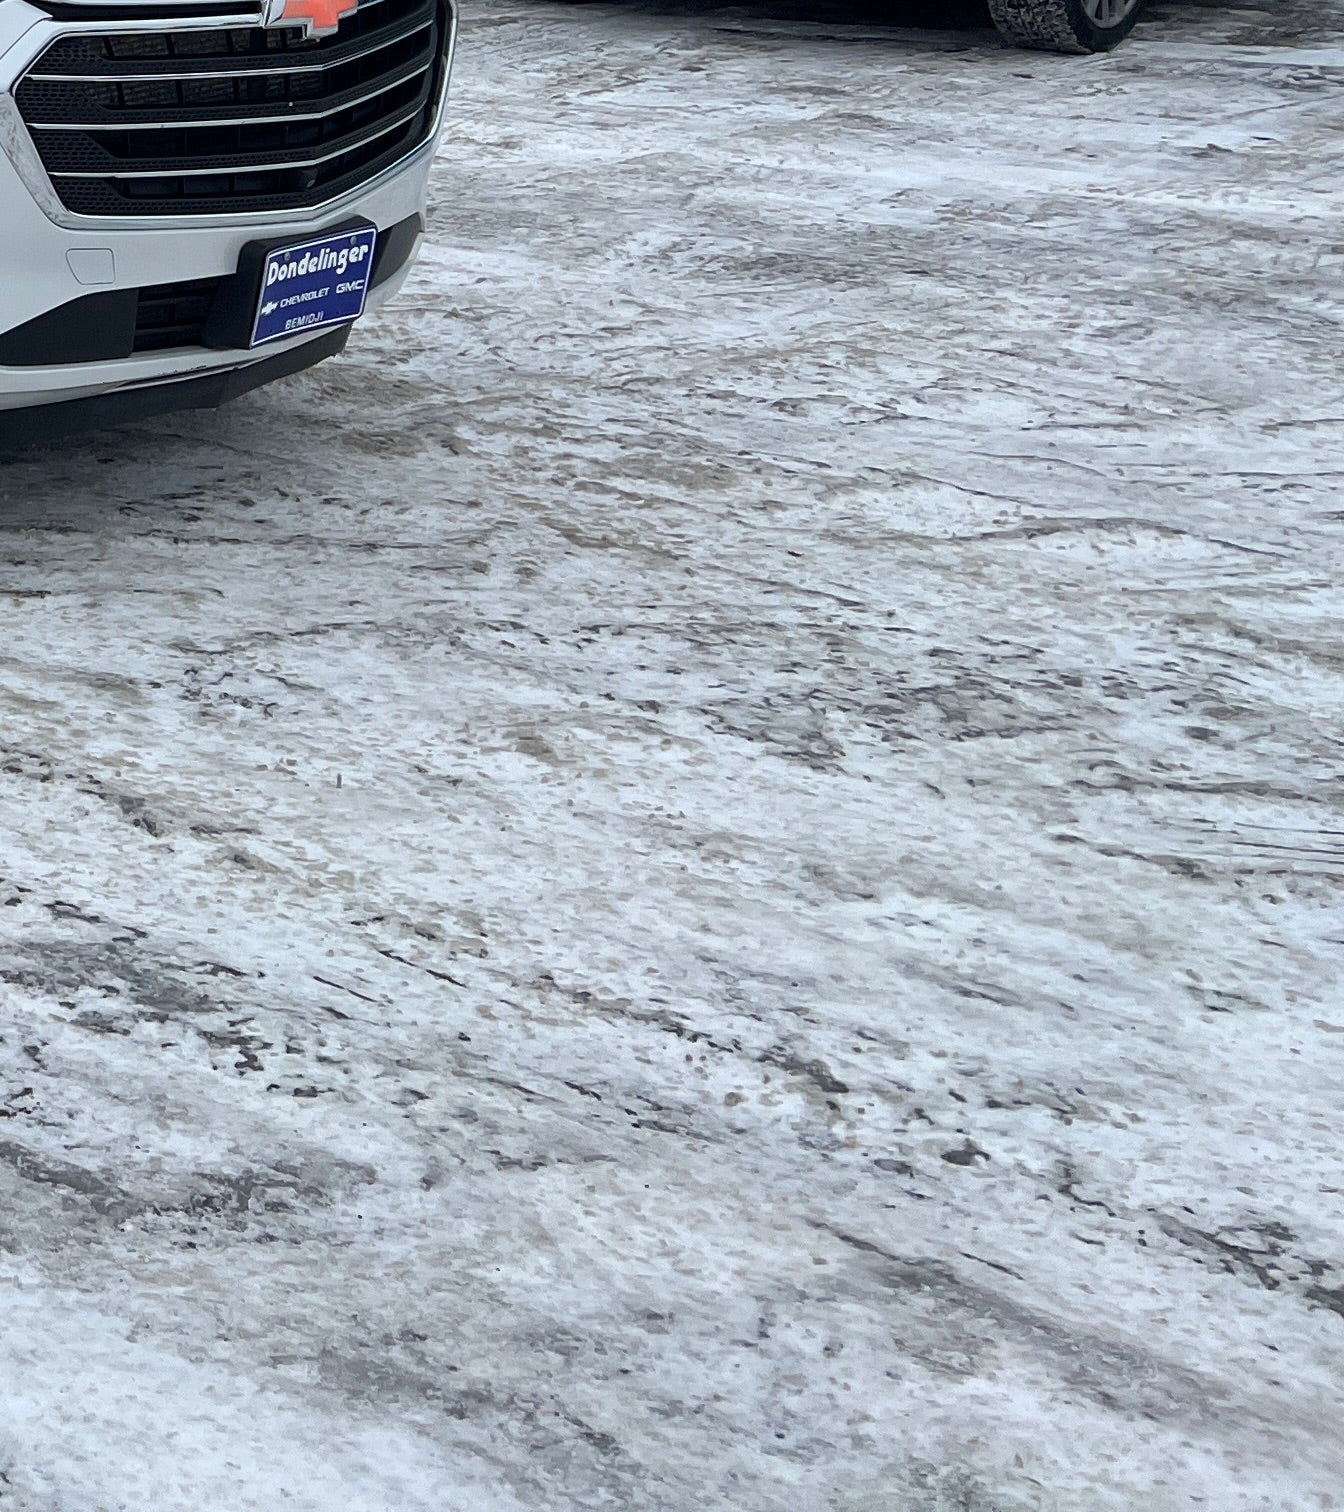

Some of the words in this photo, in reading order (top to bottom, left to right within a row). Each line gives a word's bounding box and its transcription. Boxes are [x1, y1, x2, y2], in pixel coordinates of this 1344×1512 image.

[266, 244, 369, 287] Dondelinger
[279, 286, 331, 309] CHEVROLET
[335, 279, 365, 294] GMC
[284, 310, 325, 330] BEMIDJI
